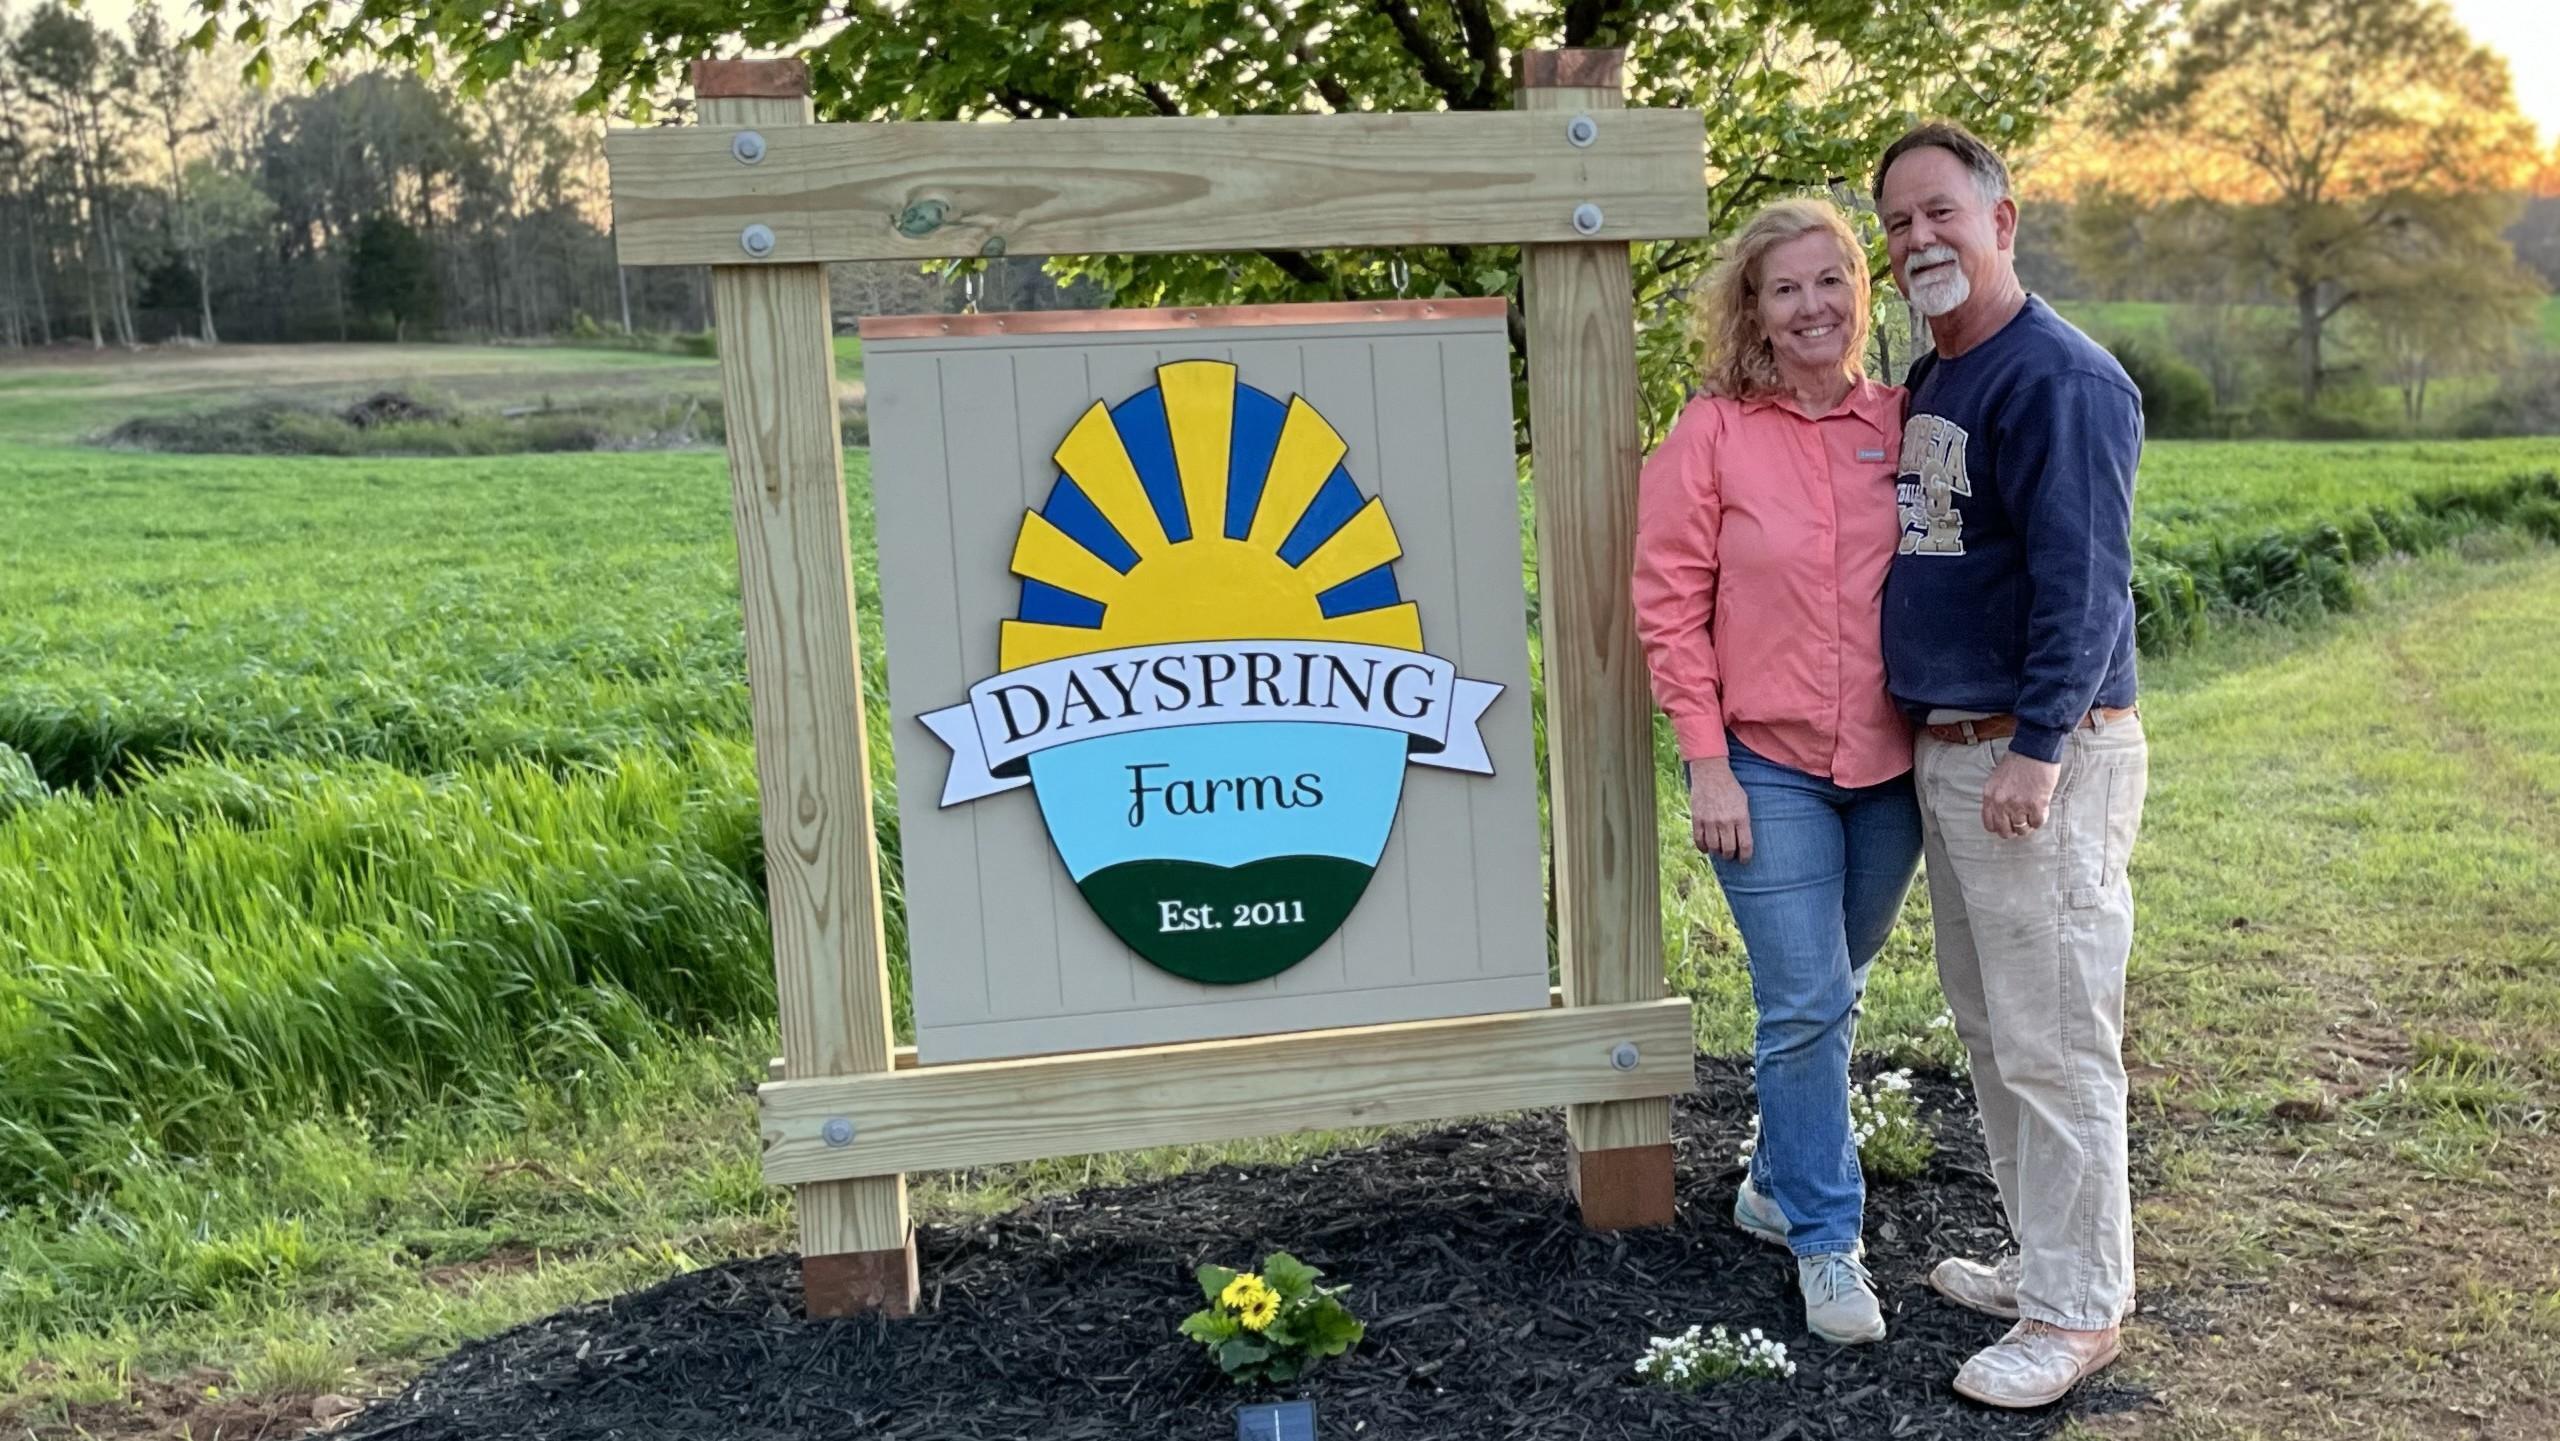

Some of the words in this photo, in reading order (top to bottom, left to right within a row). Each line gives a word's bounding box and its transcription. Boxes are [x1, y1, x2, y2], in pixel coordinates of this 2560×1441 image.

[987, 652, 1436, 745] DAYSPRING
[1125, 763, 1324, 828] Farms
[1157, 900, 1223, 933] Est.
[1232, 900, 1305, 927] 2011
